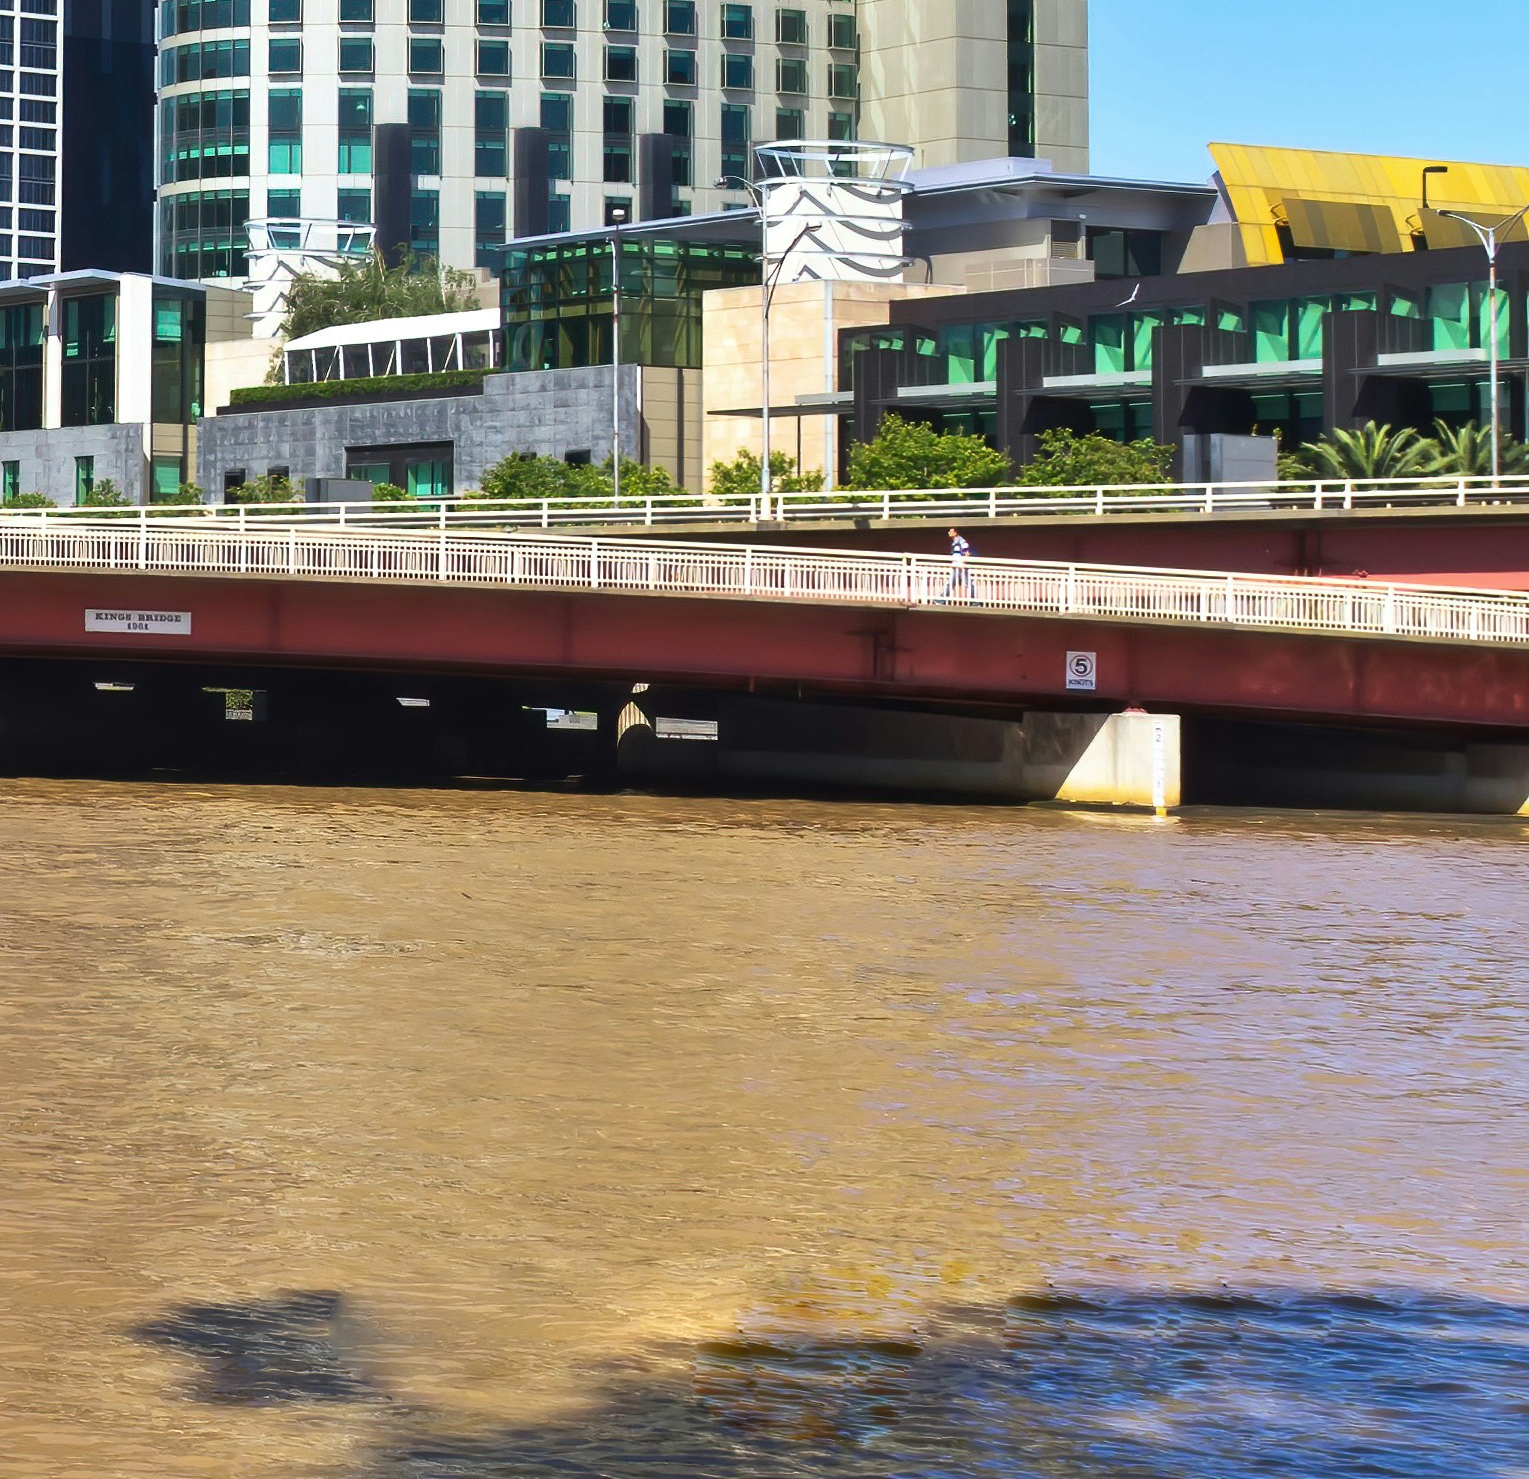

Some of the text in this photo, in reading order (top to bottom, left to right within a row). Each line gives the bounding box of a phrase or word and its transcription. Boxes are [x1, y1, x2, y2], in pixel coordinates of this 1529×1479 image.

[95, 612, 182, 623] KINGS BRIDGE
[1074, 658, 1088, 674] 5
